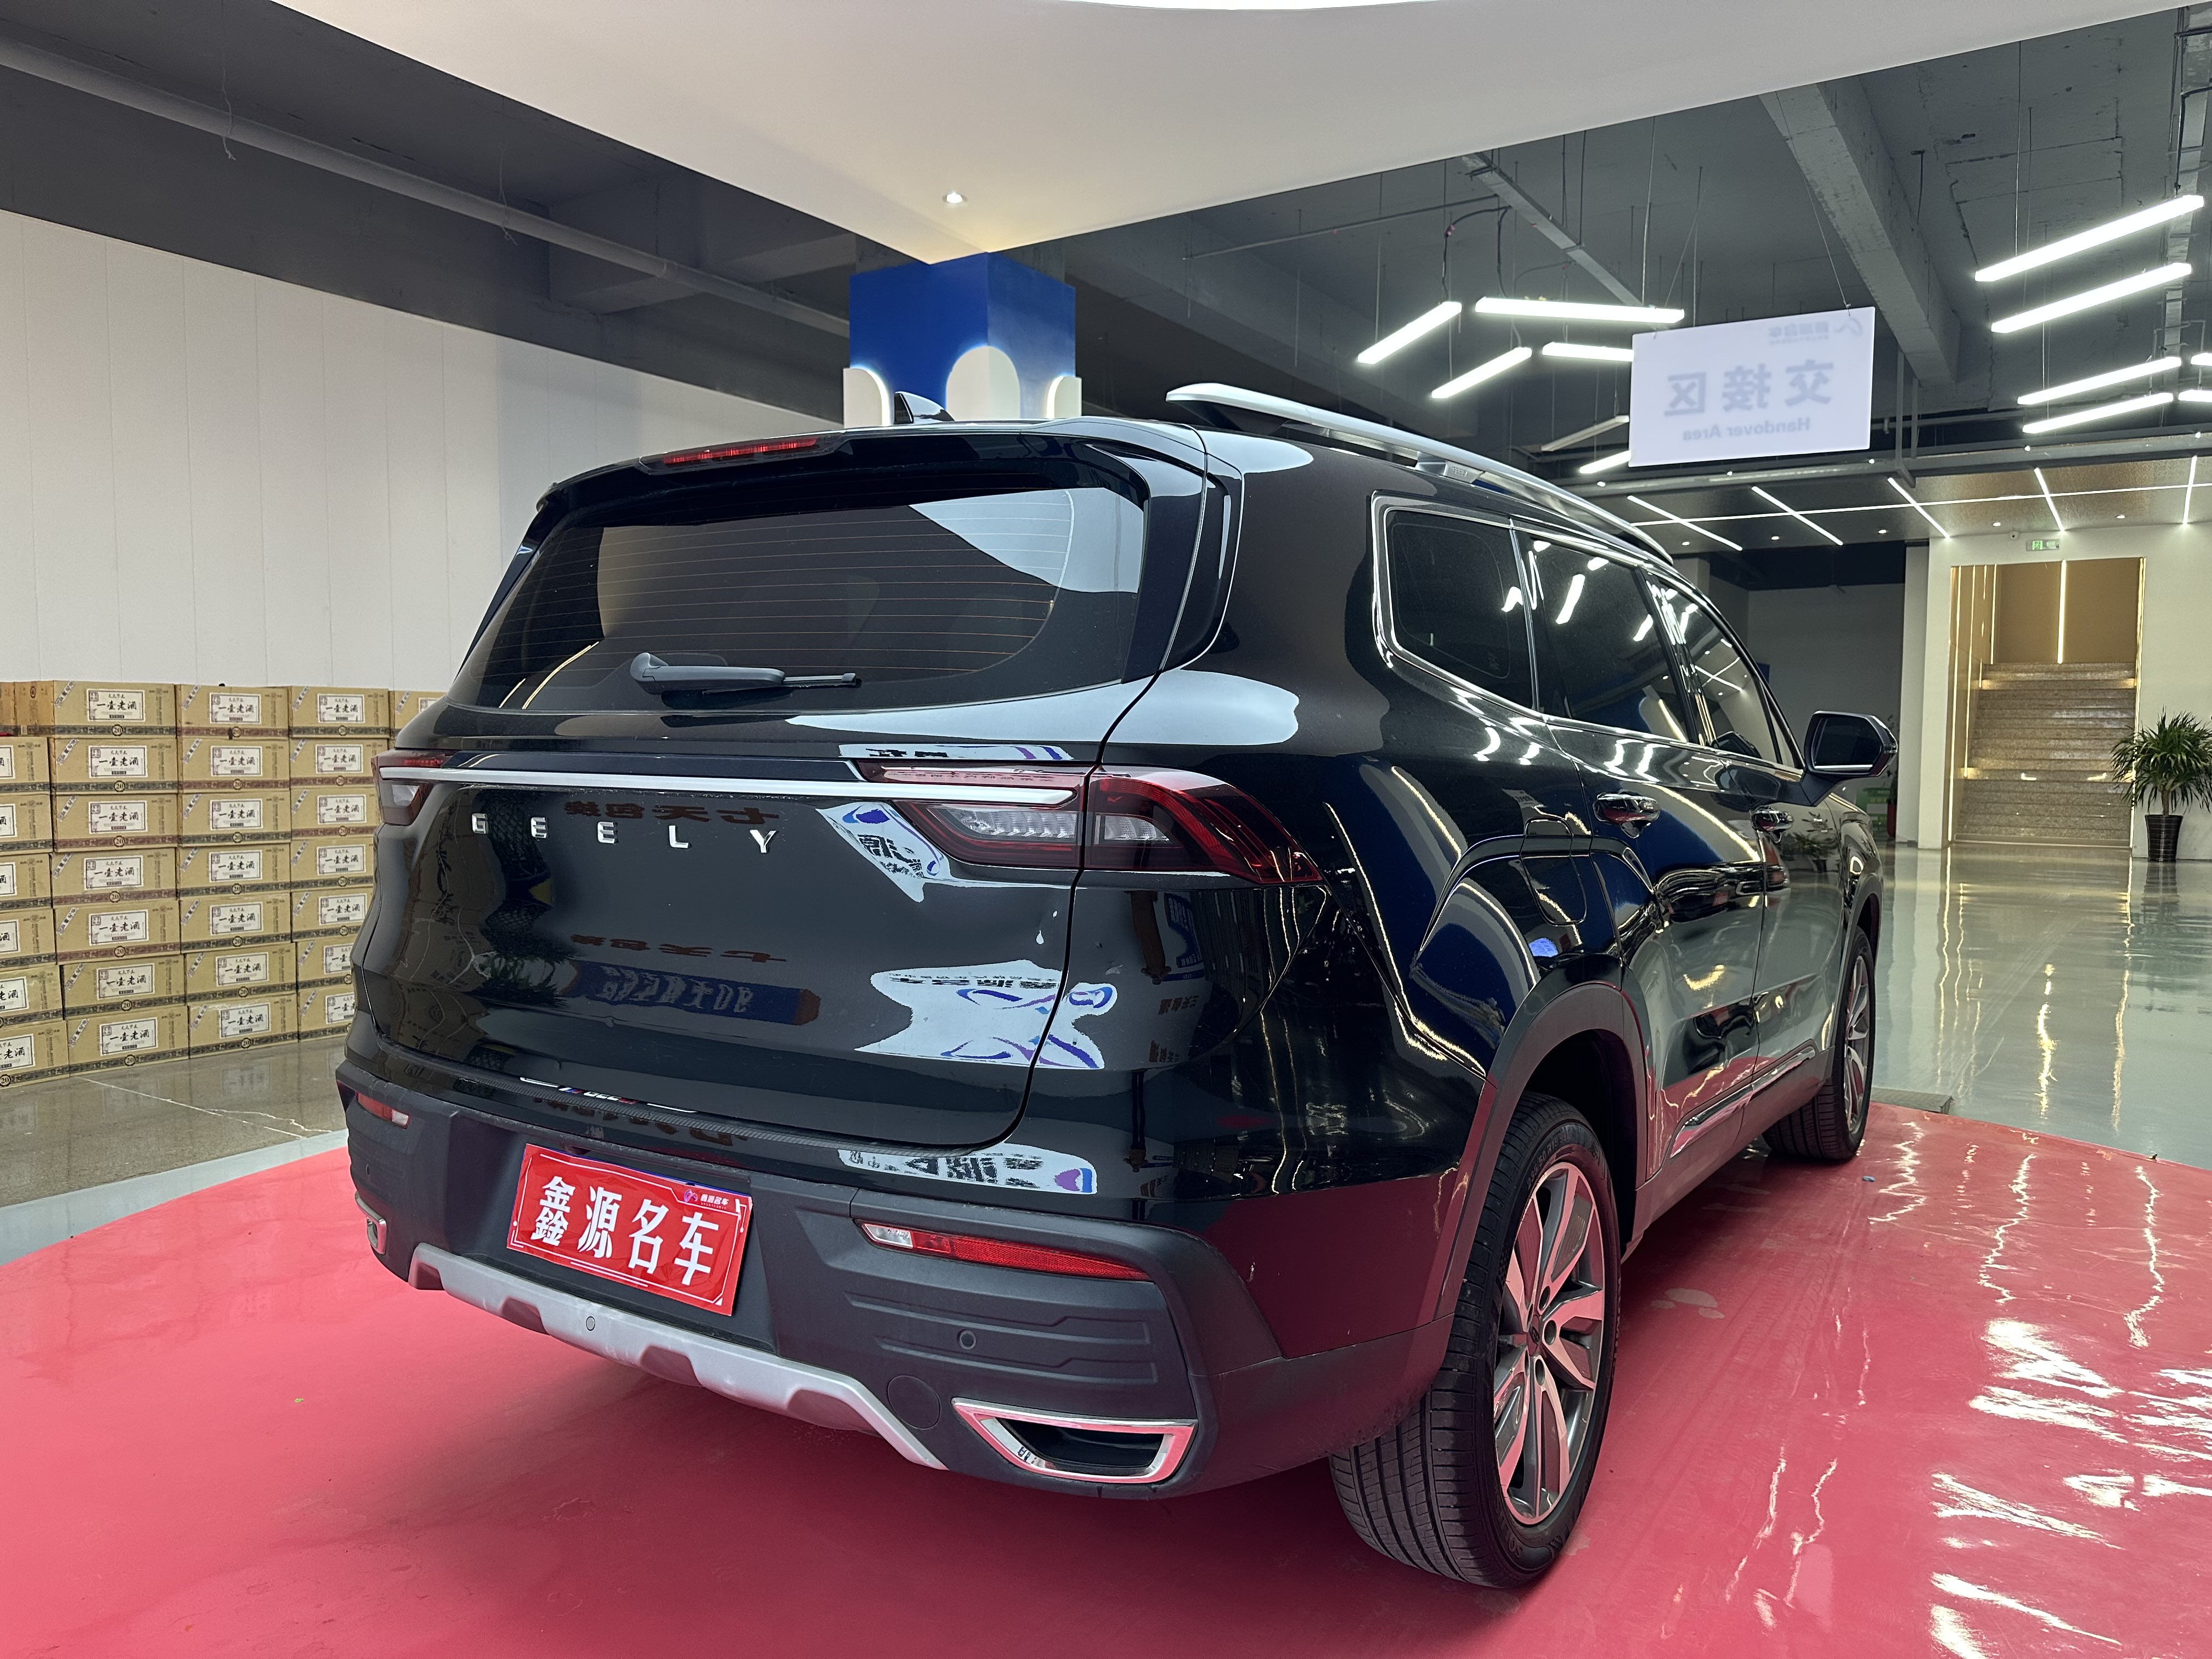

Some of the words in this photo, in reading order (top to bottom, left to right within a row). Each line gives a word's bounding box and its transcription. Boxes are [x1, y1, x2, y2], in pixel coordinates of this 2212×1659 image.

[471, 813, 777, 853] GEELY
[1, 1075, 9, 1084] 20
[530, 1176, 719, 1286] 鑫源名车
